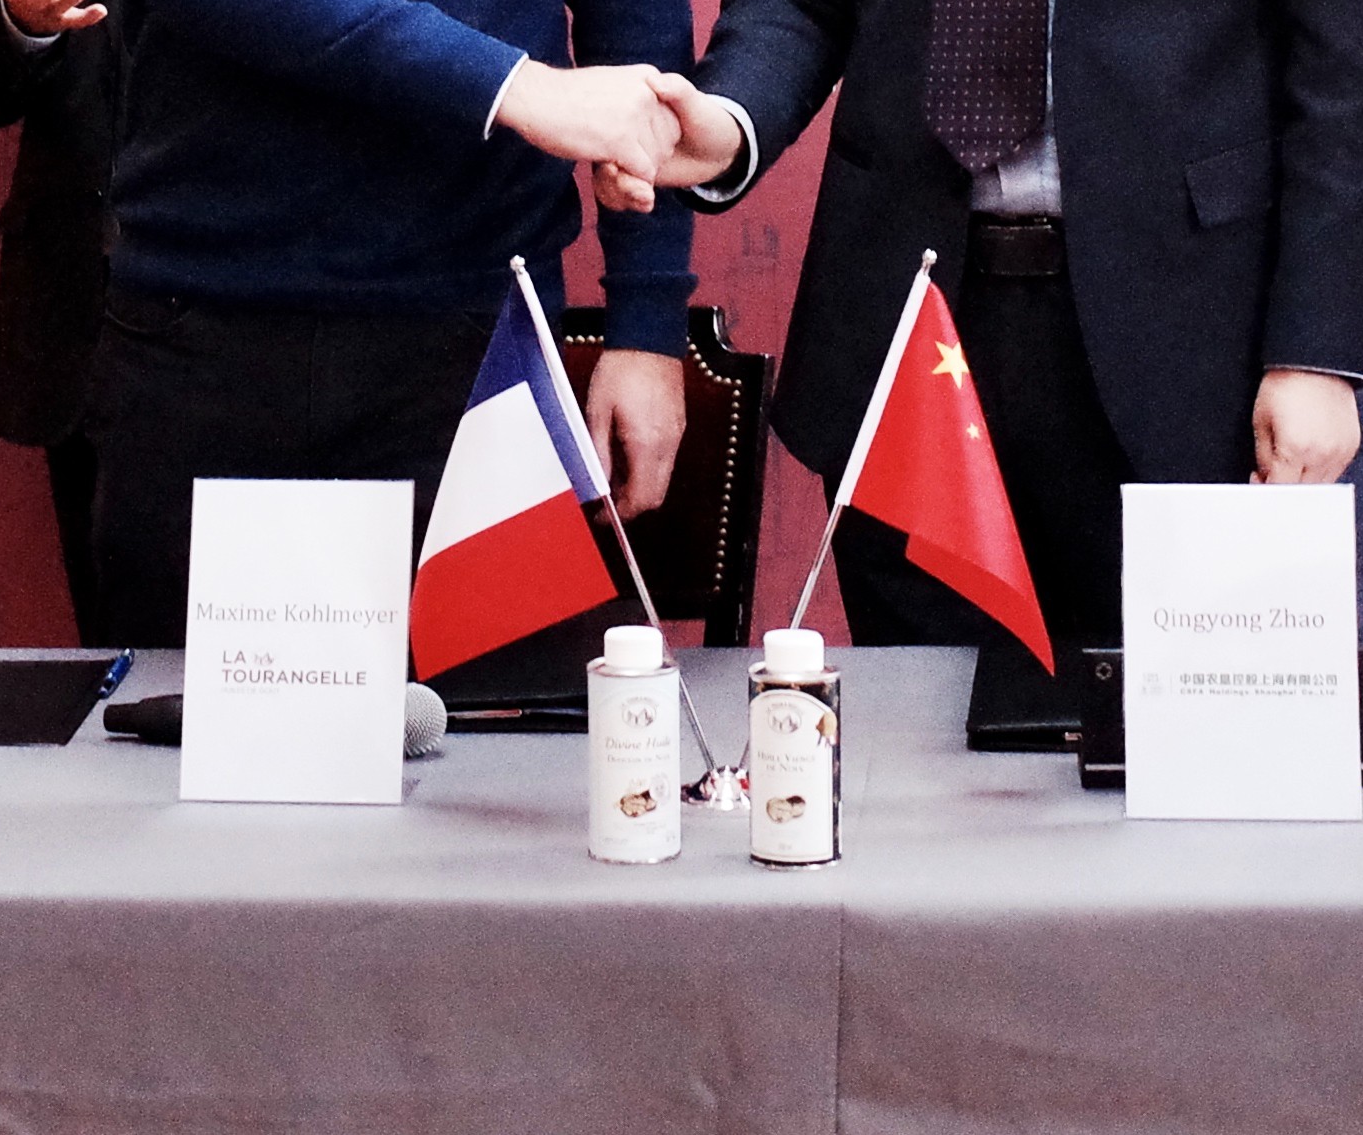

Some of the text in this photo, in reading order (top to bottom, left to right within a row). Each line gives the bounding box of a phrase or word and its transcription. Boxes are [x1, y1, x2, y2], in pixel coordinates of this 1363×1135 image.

[196, 603, 398, 628] Maxime Kohlmeyer
[1153, 607, 1325, 633] Qingyong Zhao
[222, 650, 246, 664] LA
[222, 669, 367, 685] TOURANGELLE
